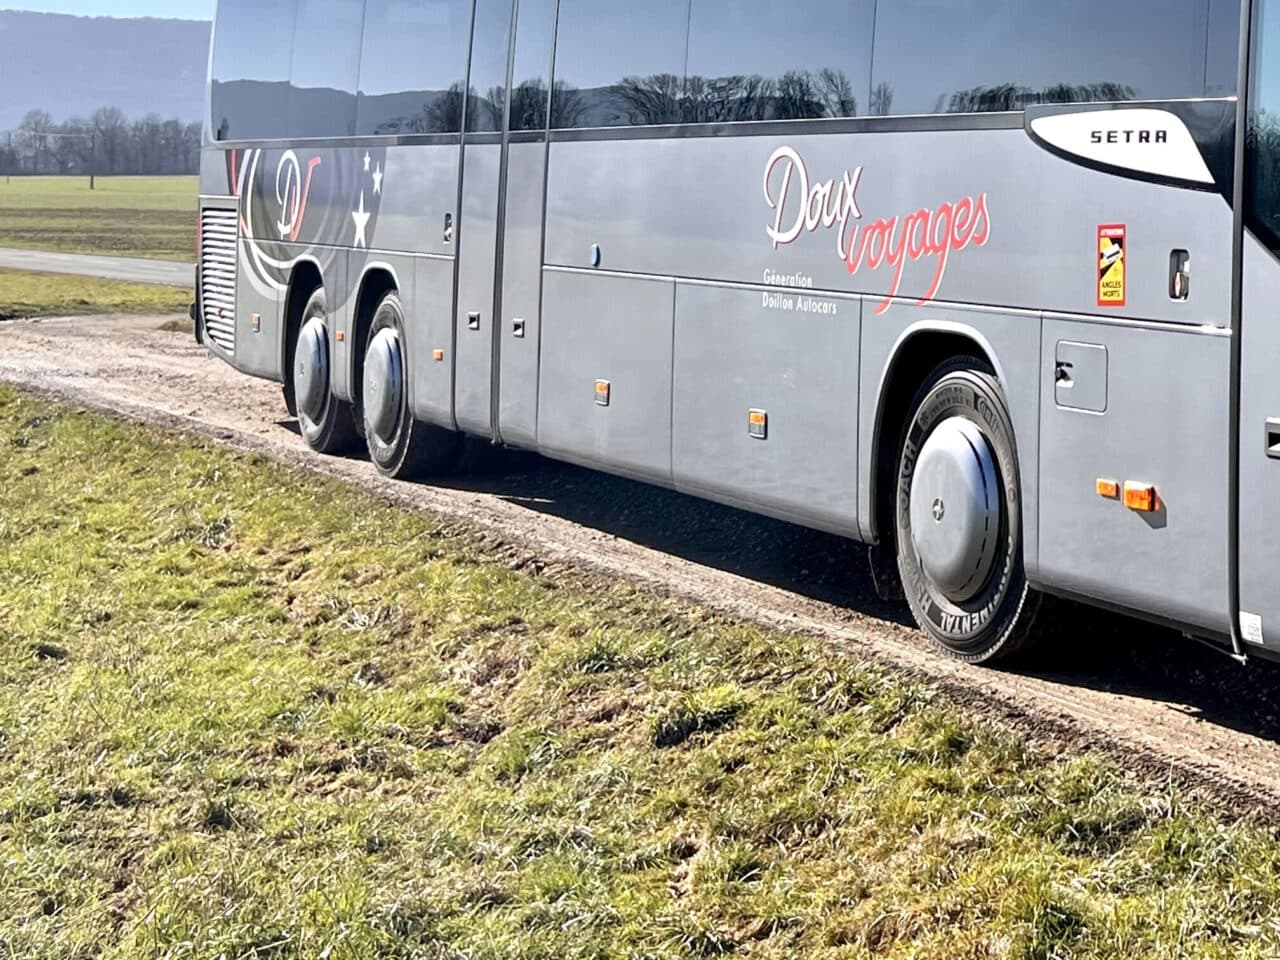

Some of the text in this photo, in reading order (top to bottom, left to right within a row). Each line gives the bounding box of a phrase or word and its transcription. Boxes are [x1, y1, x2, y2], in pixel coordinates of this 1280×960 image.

[1090, 130, 1168, 144] SETRA
[763, 145, 863, 261] Doux
[845, 192, 991, 315] voyages
[1102, 281, 1122, 289] ANGLES
[1102, 290, 1121, 298] MORTS
[762, 291, 837, 315] Doillon Autocars
